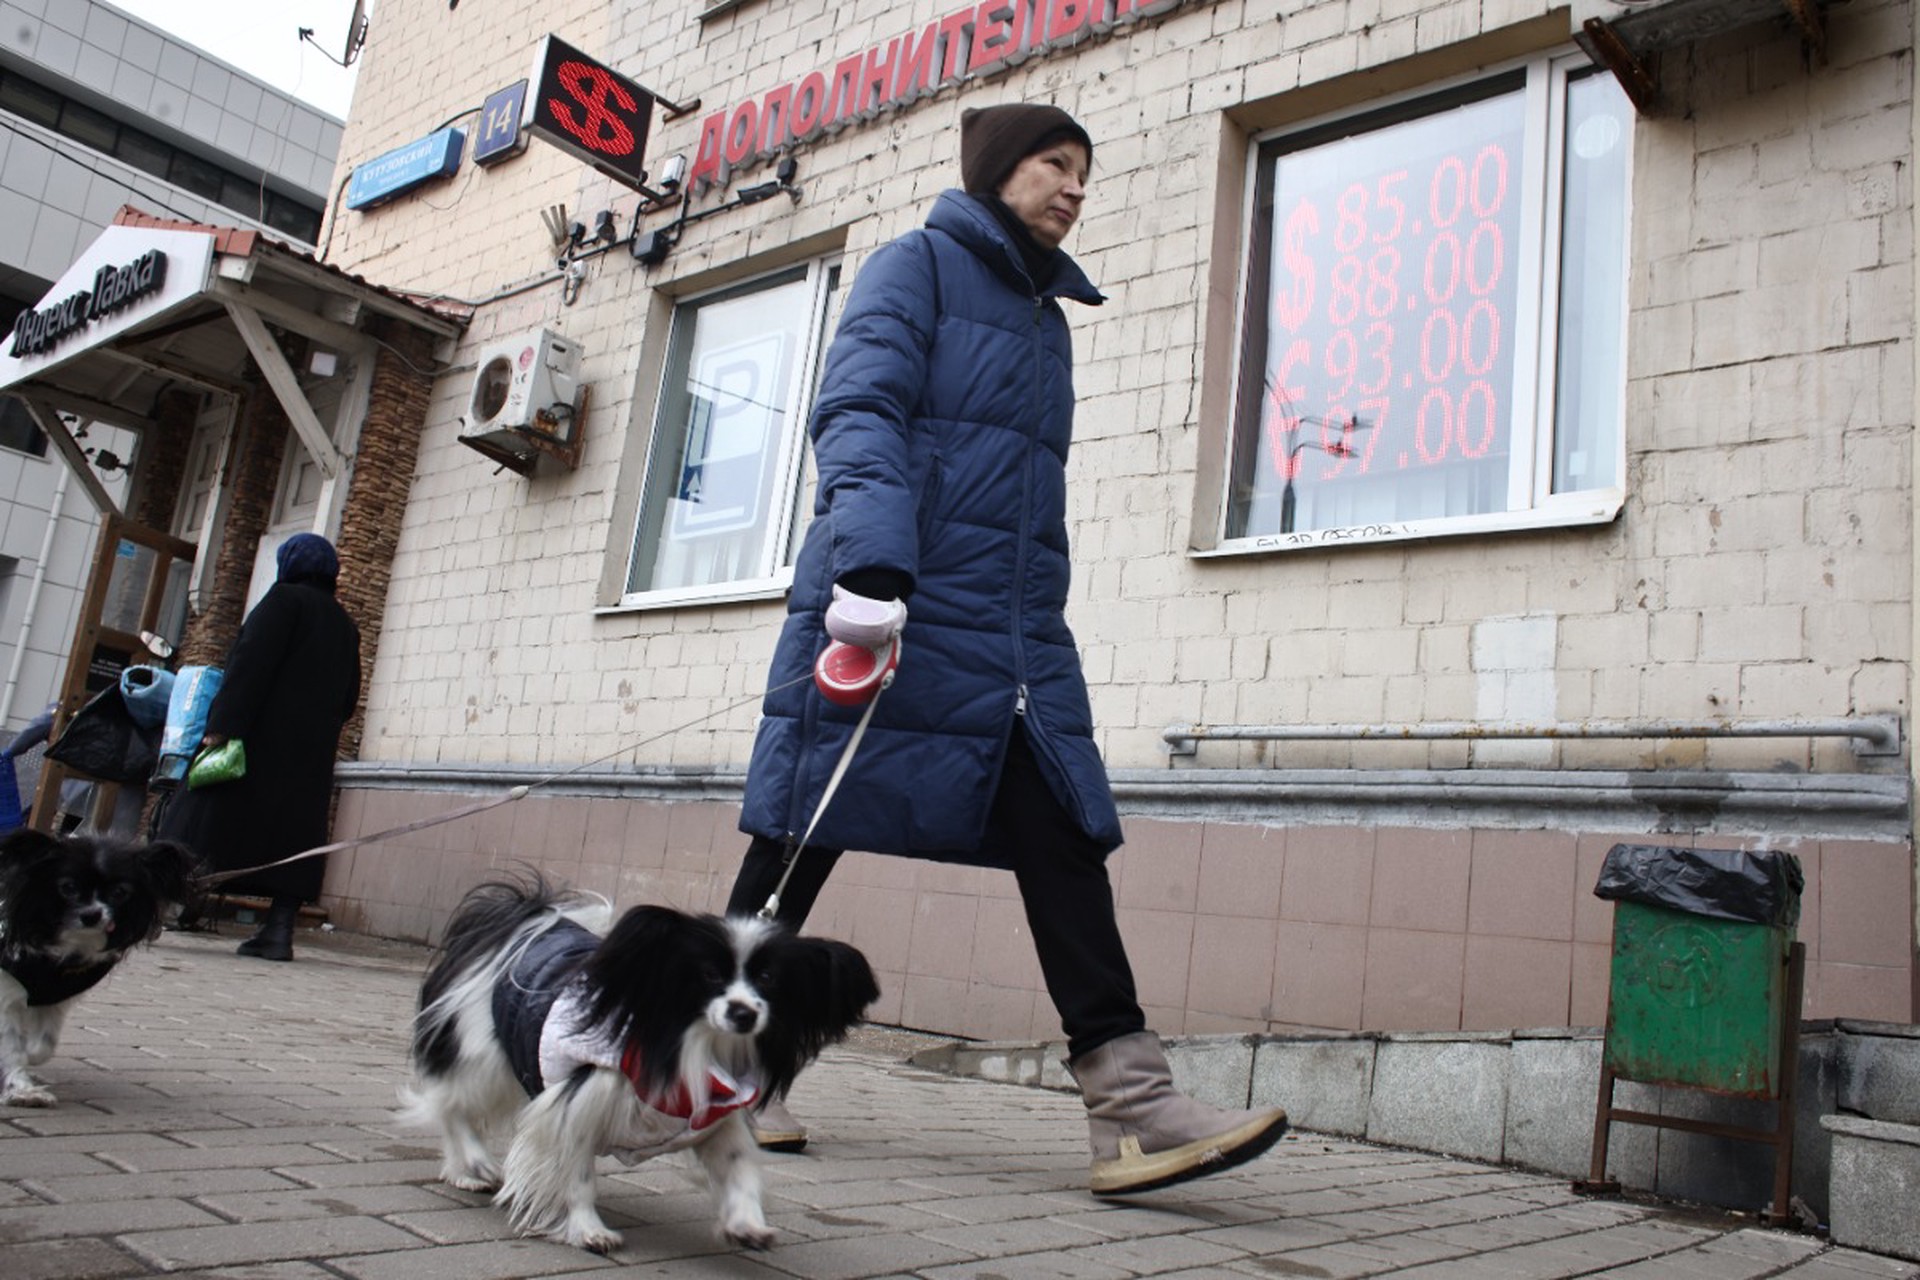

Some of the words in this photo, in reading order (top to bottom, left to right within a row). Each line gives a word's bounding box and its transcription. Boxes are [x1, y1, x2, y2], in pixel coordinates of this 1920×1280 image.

[485, 100, 513, 141] 14
[687, 0, 1180, 194] ДОПОЛНИТЕЛЬ
[1334, 144, 1508, 254] 85.00
[9, 308, 91, 358] Яндекс
[85, 248, 168, 320] Лавка
[1328, 219, 1504, 322] 88.00
[1324, 298, 1500, 405] 93.00
[1318, 379, 1496, 480] 97.00
